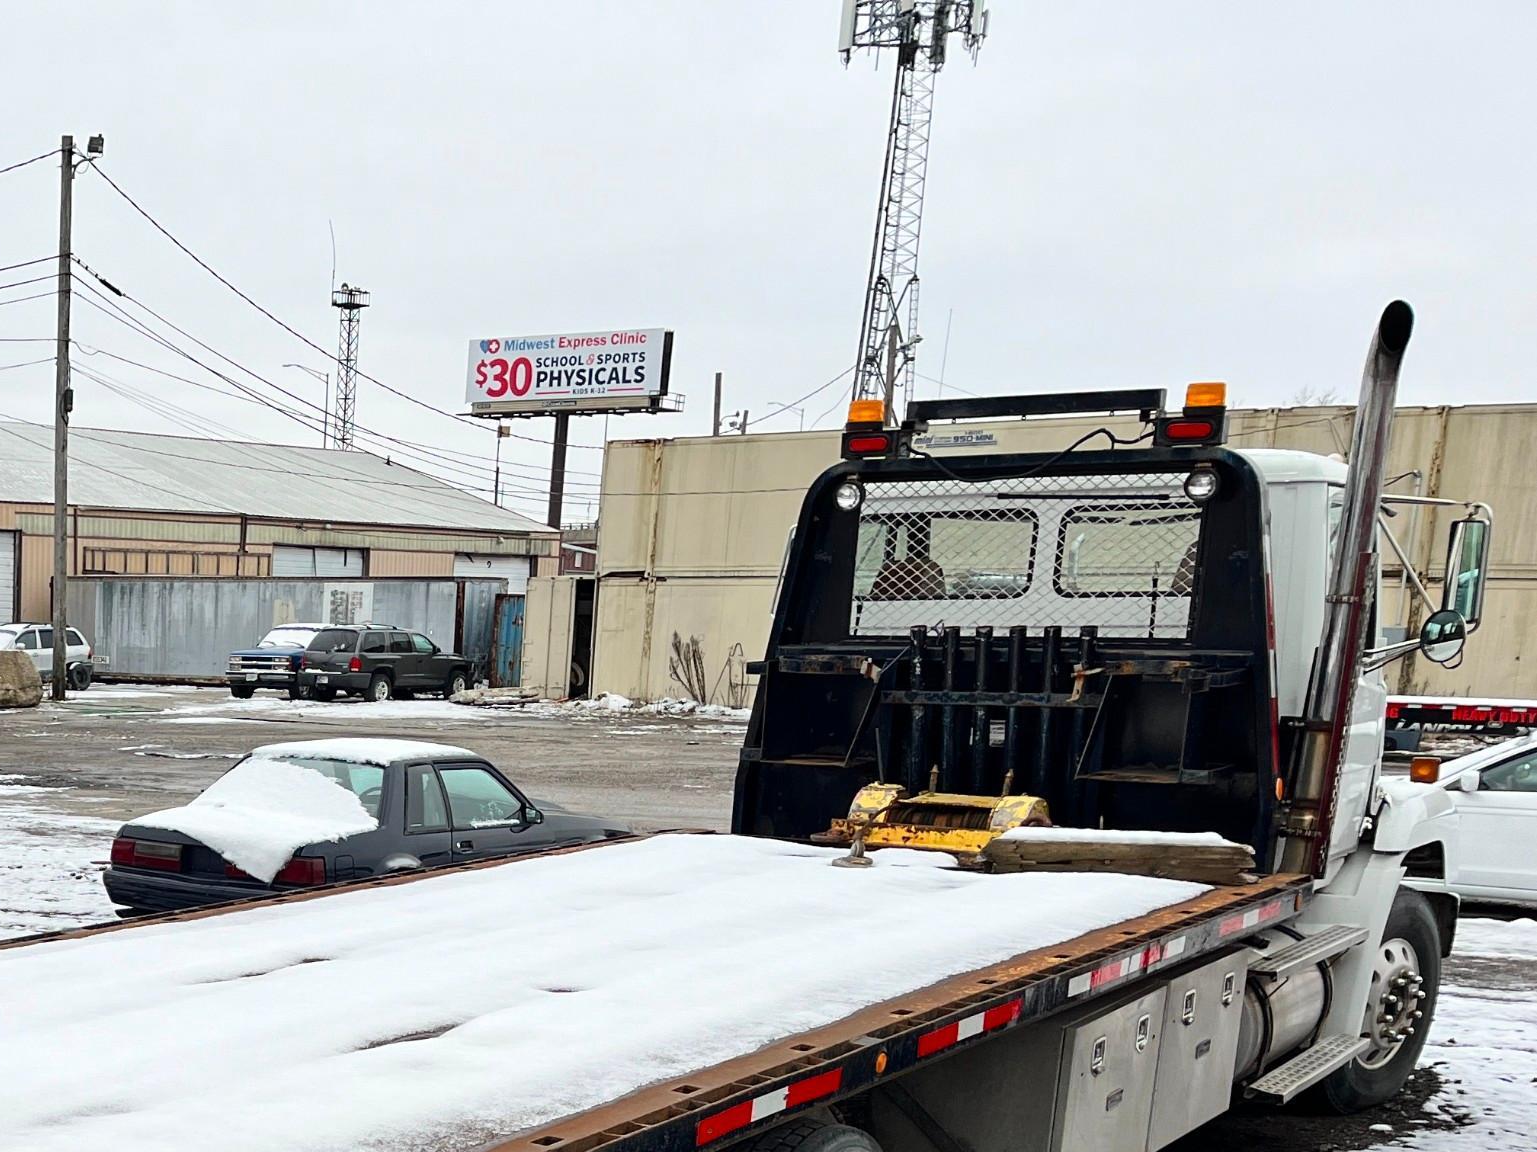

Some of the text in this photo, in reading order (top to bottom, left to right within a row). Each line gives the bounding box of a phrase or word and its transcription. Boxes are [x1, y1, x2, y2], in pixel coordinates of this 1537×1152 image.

[504, 331, 647, 352] Midwest Express Clinic
[536, 351, 646, 368] SCHOOL & SPORTS
[475, 356, 533, 398] $30
[535, 365, 646, 388] PHYSICALS
